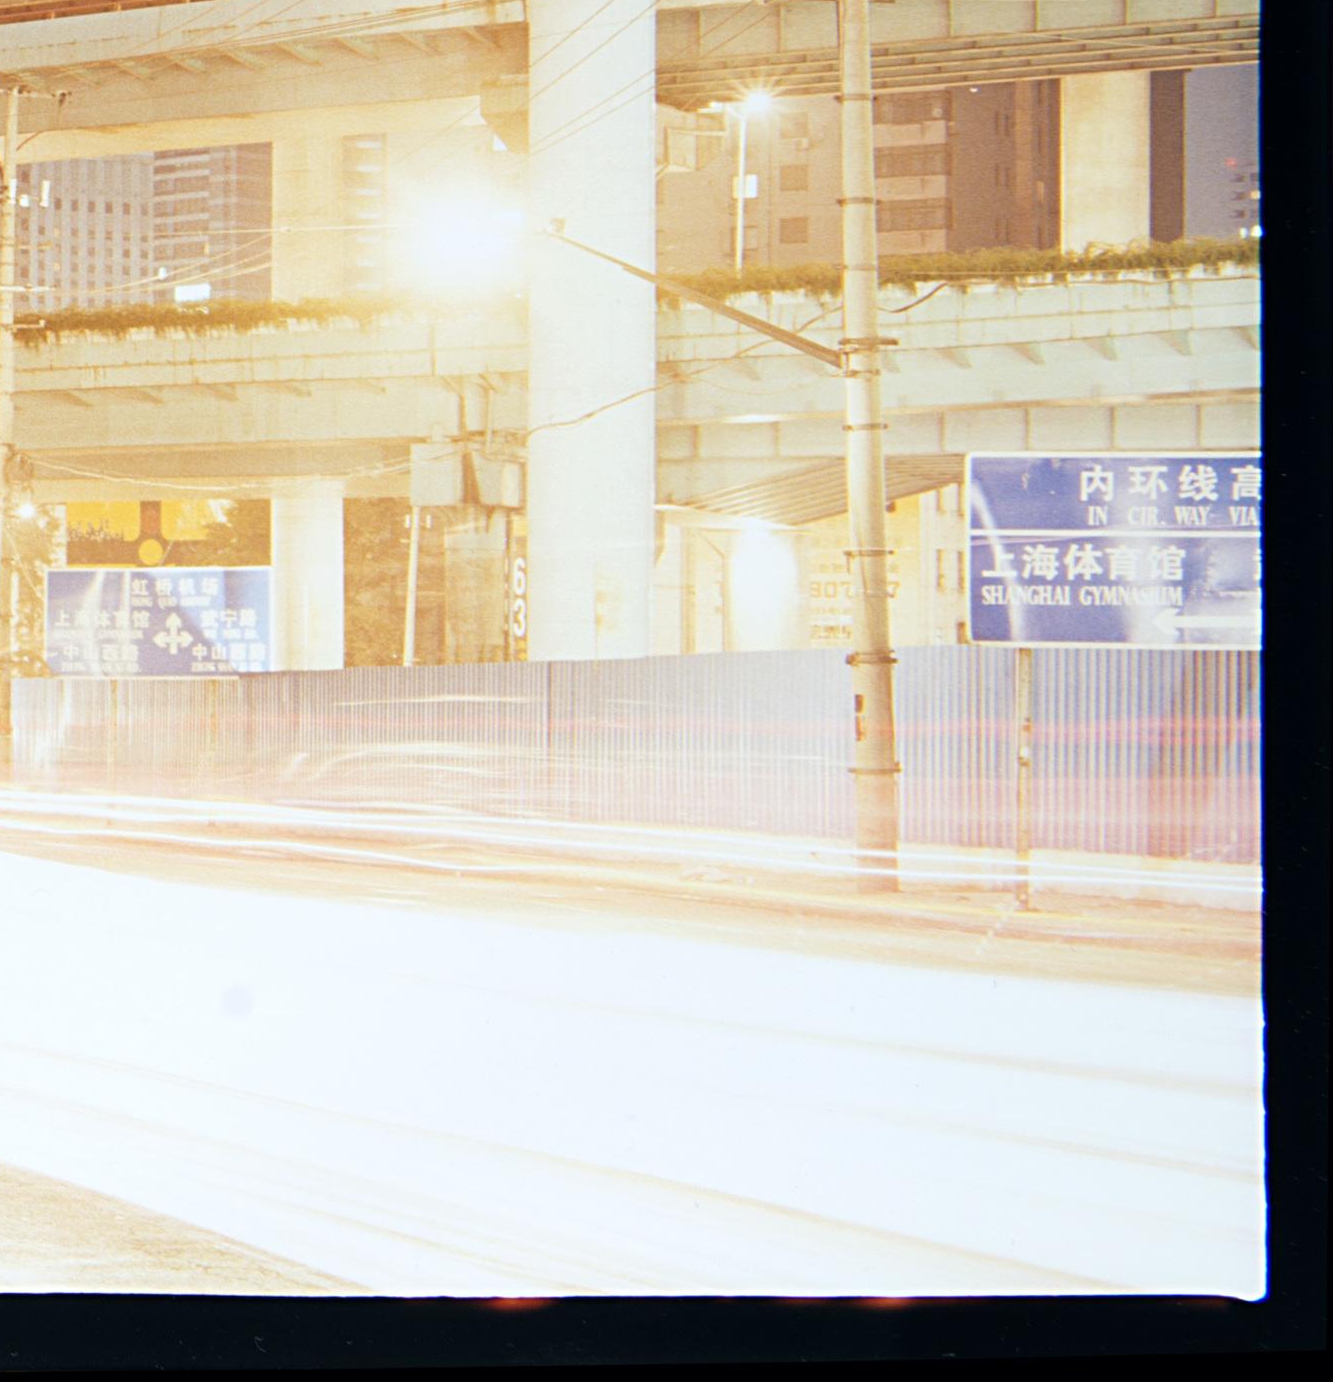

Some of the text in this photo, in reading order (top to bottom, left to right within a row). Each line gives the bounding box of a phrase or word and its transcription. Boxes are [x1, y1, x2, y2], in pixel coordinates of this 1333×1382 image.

[1087, 505, 1108, 526] IN
[1128, 505, 1167, 527] CIR.
[1175, 505, 1210, 527] WAY
[982, 544, 1187, 581] 上海体育馆
[982, 585, 1183, 607] SHANGHAI GYMNASIUM
